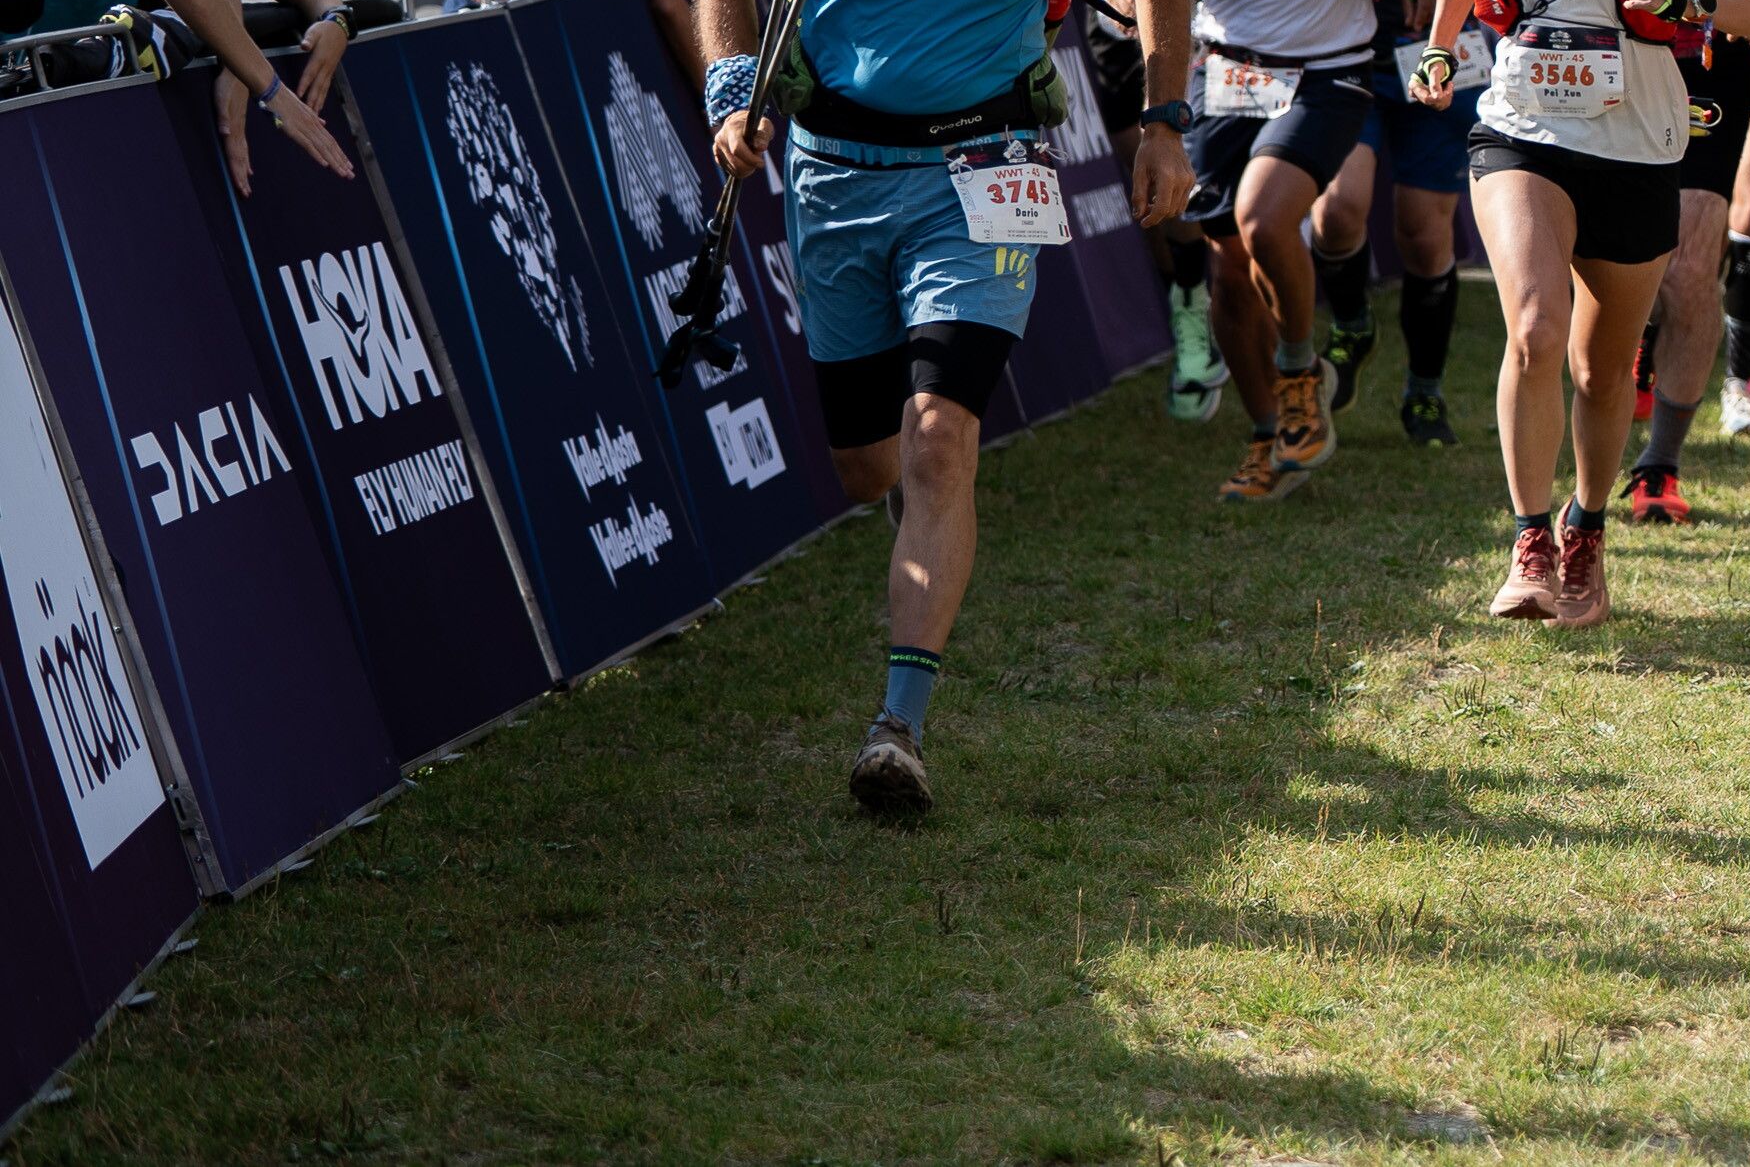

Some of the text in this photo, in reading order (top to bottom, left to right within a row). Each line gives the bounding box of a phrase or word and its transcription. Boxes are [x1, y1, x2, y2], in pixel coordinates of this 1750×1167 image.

[1539, 53, 1564, 62] WWT
[1572, 54, 1585, 62] 45
[1530, 62, 1595, 86] 3546
[1608, 76, 1614, 84] 2
[1544, 88, 1582, 97] Pei Xun
[994, 168, 1024, 180] WWT
[1032, 167, 1041, 178] 45
[986, 180, 1050, 205] 3745
[1015, 207, 1039, 218] Dario
[279, 241, 444, 431] HOKA
[739, 416, 774, 470] UTMB
[131, 393, 293, 526] DACIA
[354, 439, 475, 536] FLY HUMAN FLY
